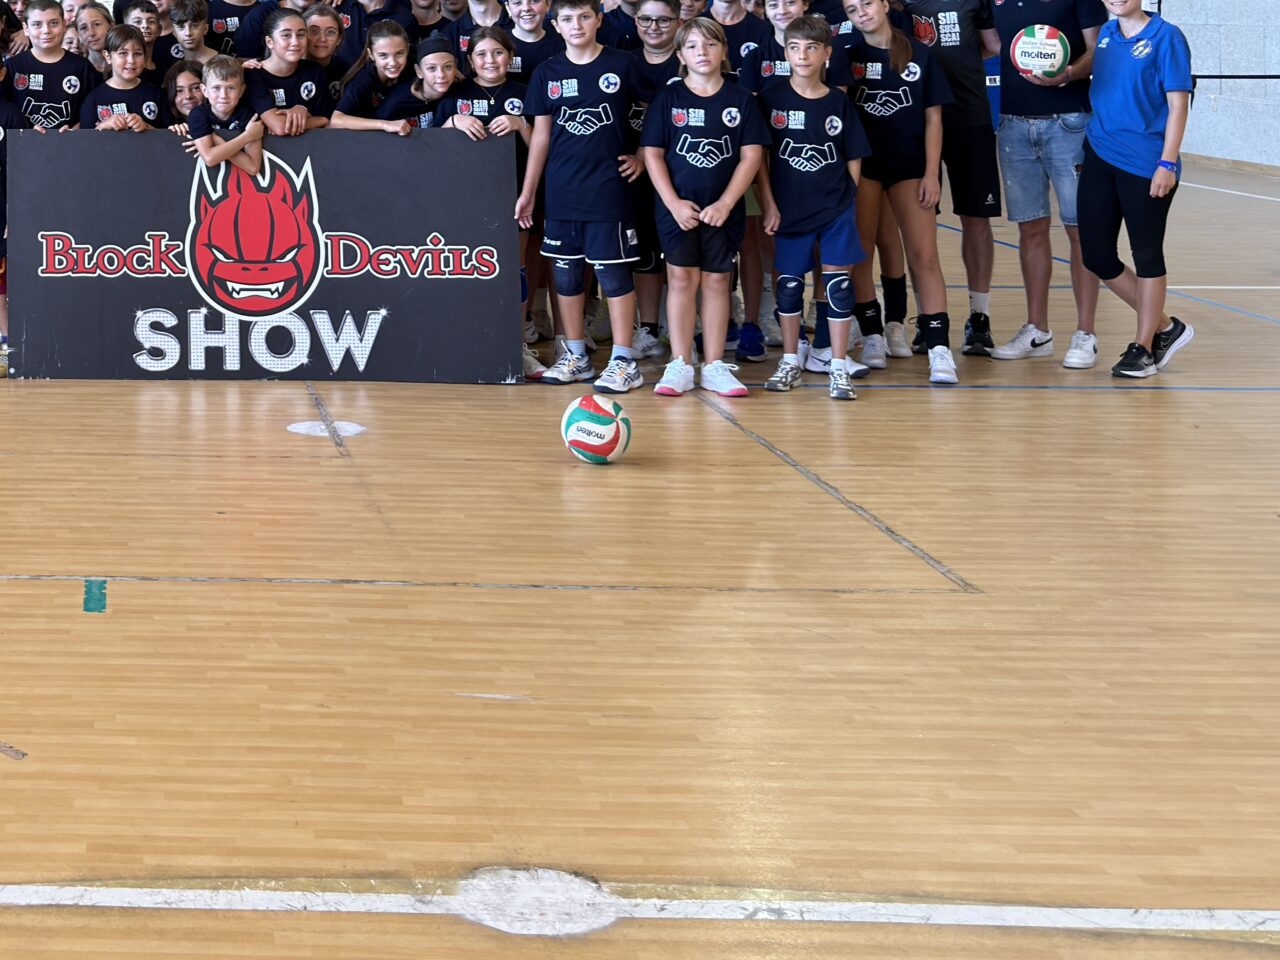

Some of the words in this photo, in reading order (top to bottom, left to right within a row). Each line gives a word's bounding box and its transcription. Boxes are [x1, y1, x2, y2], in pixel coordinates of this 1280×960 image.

[938, 11, 958, 24] SIR
[939, 24, 960, 33] SUSA
[940, 32, 960, 42] SCAI
[1021, 50, 1056, 60] molten
[775, 60, 790, 69] SIR
[866, 63, 881, 71] SIR
[30, 74, 43, 83] SIR
[562, 79, 577, 88] SIR
[113, 103, 126, 112] SIR
[473, 100, 488, 108] SIR
[689, 108, 704, 118] SIR
[789, 110, 805, 120] SIR
[133, 308, 386, 373] SHOW
